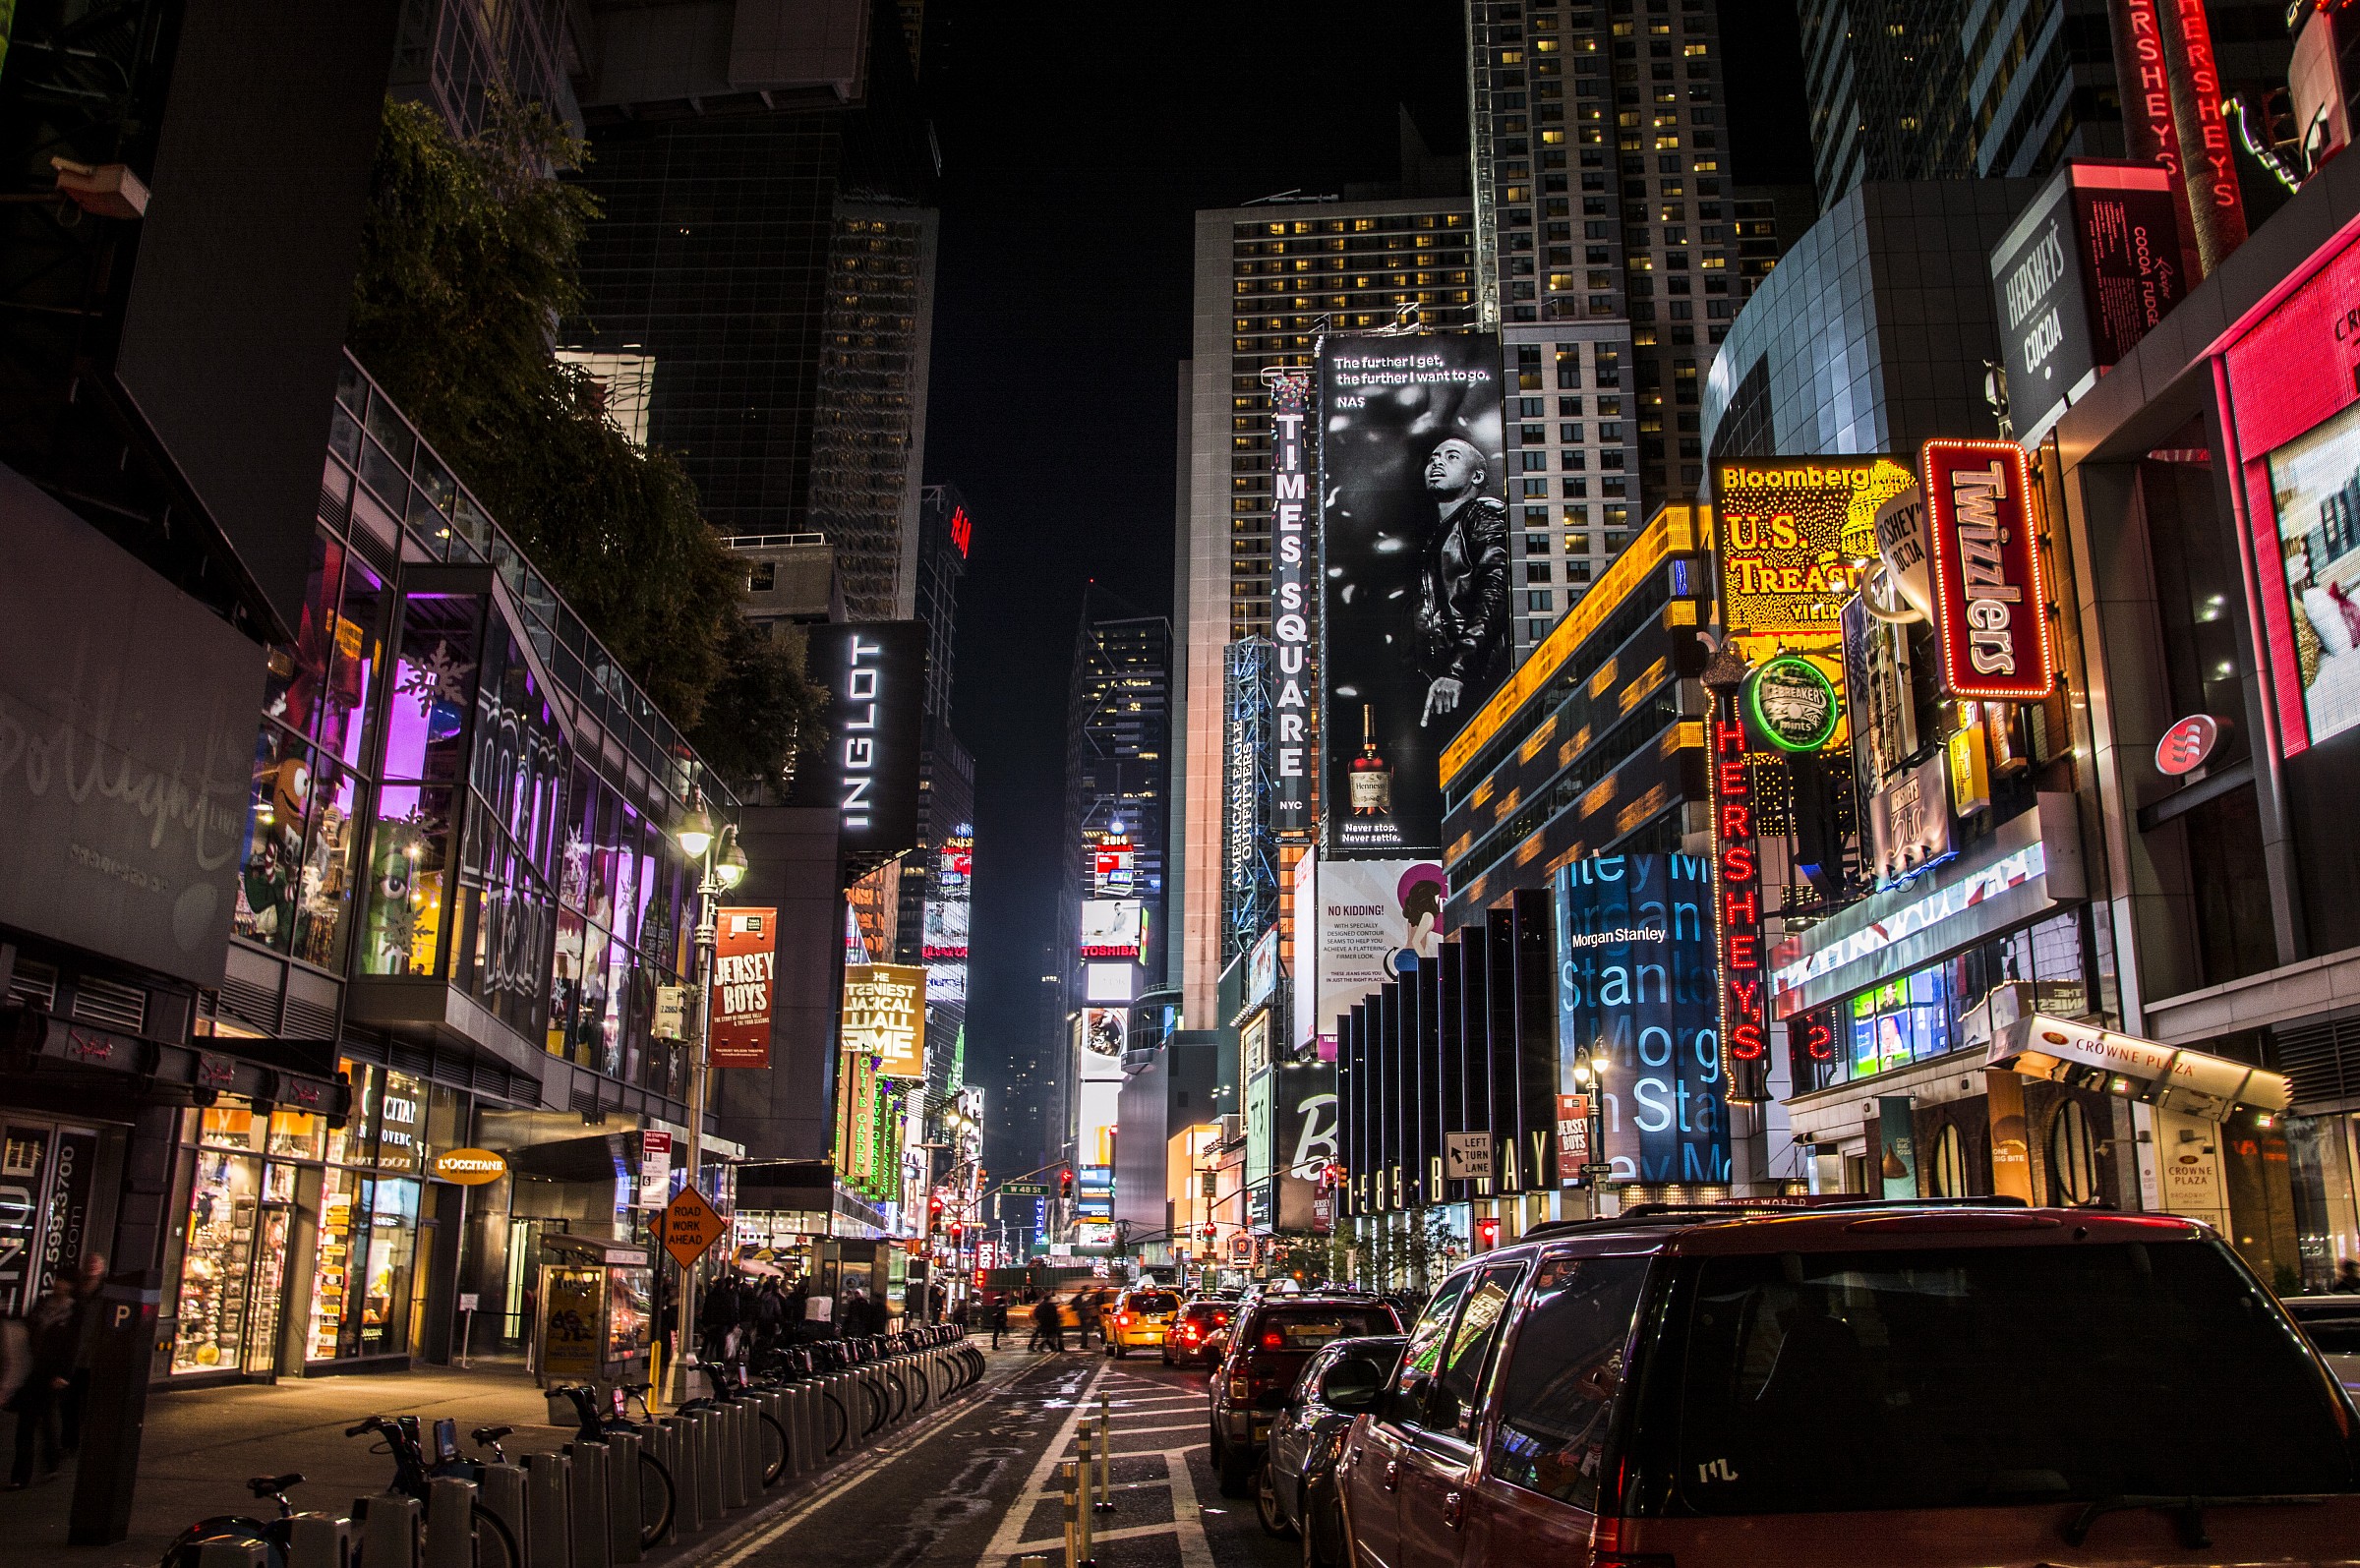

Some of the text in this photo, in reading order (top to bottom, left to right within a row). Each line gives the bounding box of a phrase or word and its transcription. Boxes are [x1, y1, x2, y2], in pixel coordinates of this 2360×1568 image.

[2006, 217, 2064, 331] HERSHEY'S
[2134, 226, 2160, 327] COCOA FUDGE
[2024, 307, 2063, 375] COCOA
[1334, 357, 1359, 369] The
[1362, 356, 1408, 369] further
[1336, 374, 1359, 385] the
[1362, 372, 1408, 384] further
[1417, 371, 1450, 382] want
[1451, 370, 1466, 380] to
[1337, 396, 1366, 408] NAS
[1723, 466, 1870, 491] Bloomberg
[1725, 514, 1809, 550] U.S.
[1952, 460, 2023, 676] Twizzlers
[1275, 414, 1307, 777] TIMES SQUARE
[842, 635, 880, 827] INGLOT
[1780, 720, 1811, 731] mints
[1232, 720, 1243, 888] AMERICAN EAGLE
[1242, 742, 1253, 860] OUTFITTERS
[1279, 801, 1303, 810] NYC
[1345, 823, 1398, 833] Never stop.
[1101, 836, 1128, 845] 2014
[1342, 834, 1401, 842] Never settle.
[1717, 720, 1763, 1061] HERSHEY'S
[1328, 904, 1385, 916] NO KIDDING!
[1572, 926, 1666, 948] Morgan Stanley
[1083, 946, 1139, 957] TOSHIBA
[714, 952, 775, 986] JERSEY
[723, 982, 767, 1014] BOYS
[2076, 1038, 2193, 1077] CROWNE PLAZA
[855, 1057, 870, 1175] OLIVE GARDEN
[868, 1081, 883, 1186] OLIVE GARDEN
[1558, 1118, 1588, 1136] JERSEY
[1464, 1137, 1487, 1148] LEFT
[1562, 1133, 1586, 1150] BOYS
[1464, 1150, 1489, 1160] TURN
[438, 1158, 503, 1171] L'OCCITANE
[1465, 1162, 1489, 1173] LANE
[2168, 1166, 2212, 1176] CROWNE
[2174, 1176, 2208, 1186] PLAZA
[675, 1206, 701, 1217] ROAD
[673, 1221, 700, 1231] WORK
[669, 1235, 703, 1245] AHEAD
